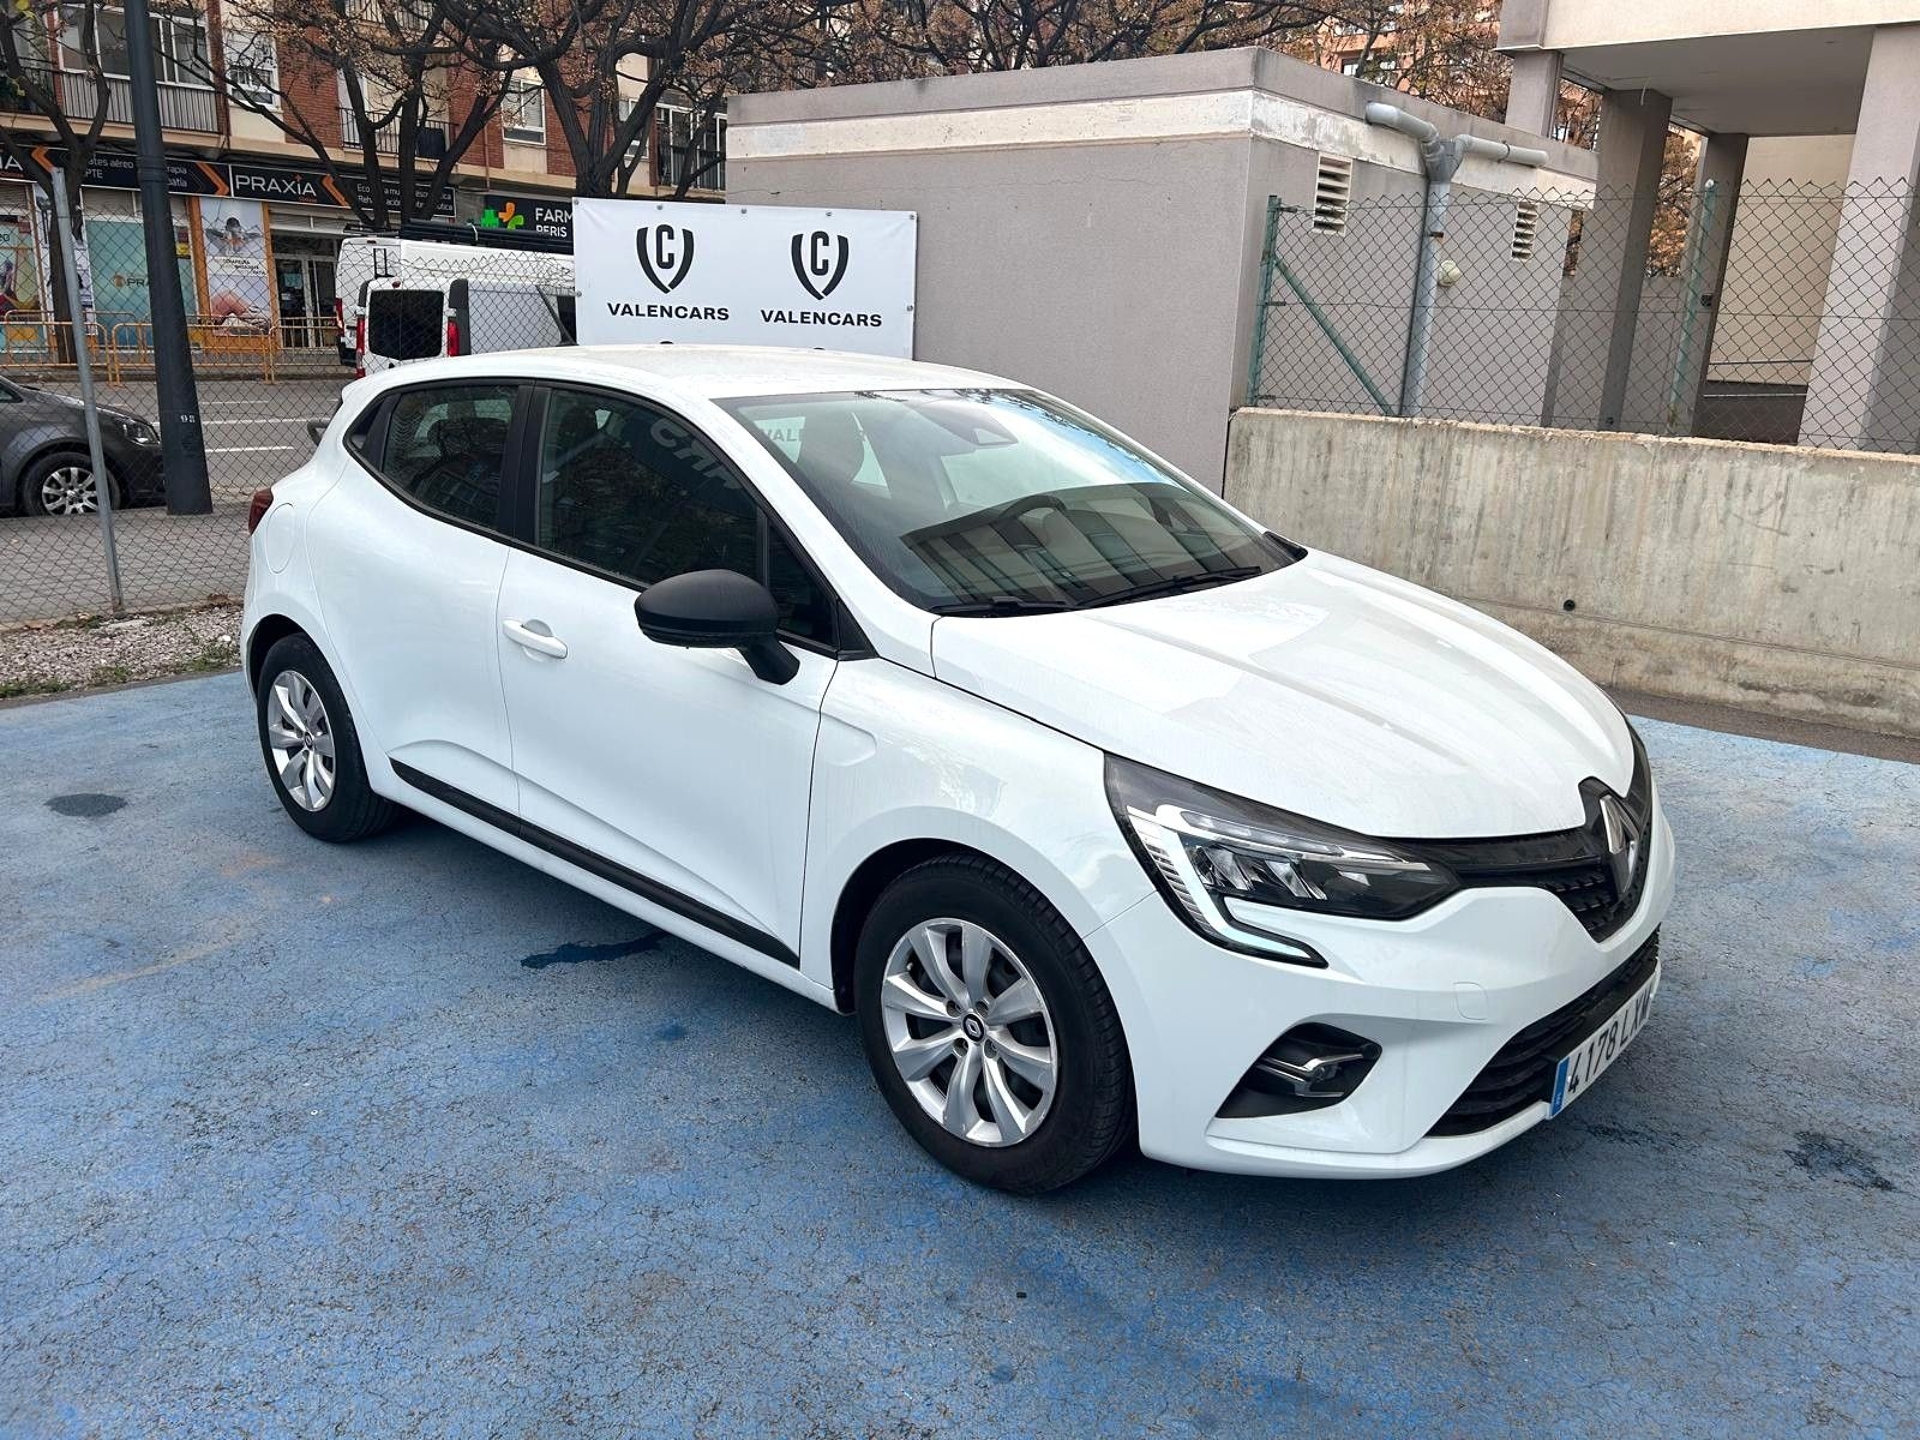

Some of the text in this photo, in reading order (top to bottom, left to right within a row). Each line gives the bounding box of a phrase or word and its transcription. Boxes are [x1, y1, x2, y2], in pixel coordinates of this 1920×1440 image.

[167, 165, 187, 175] rapia
[607, 302, 729, 321] VALENCARS
[760, 309, 882, 327] VALENCARS
[1568, 1020, 1619, 1094] 4178
